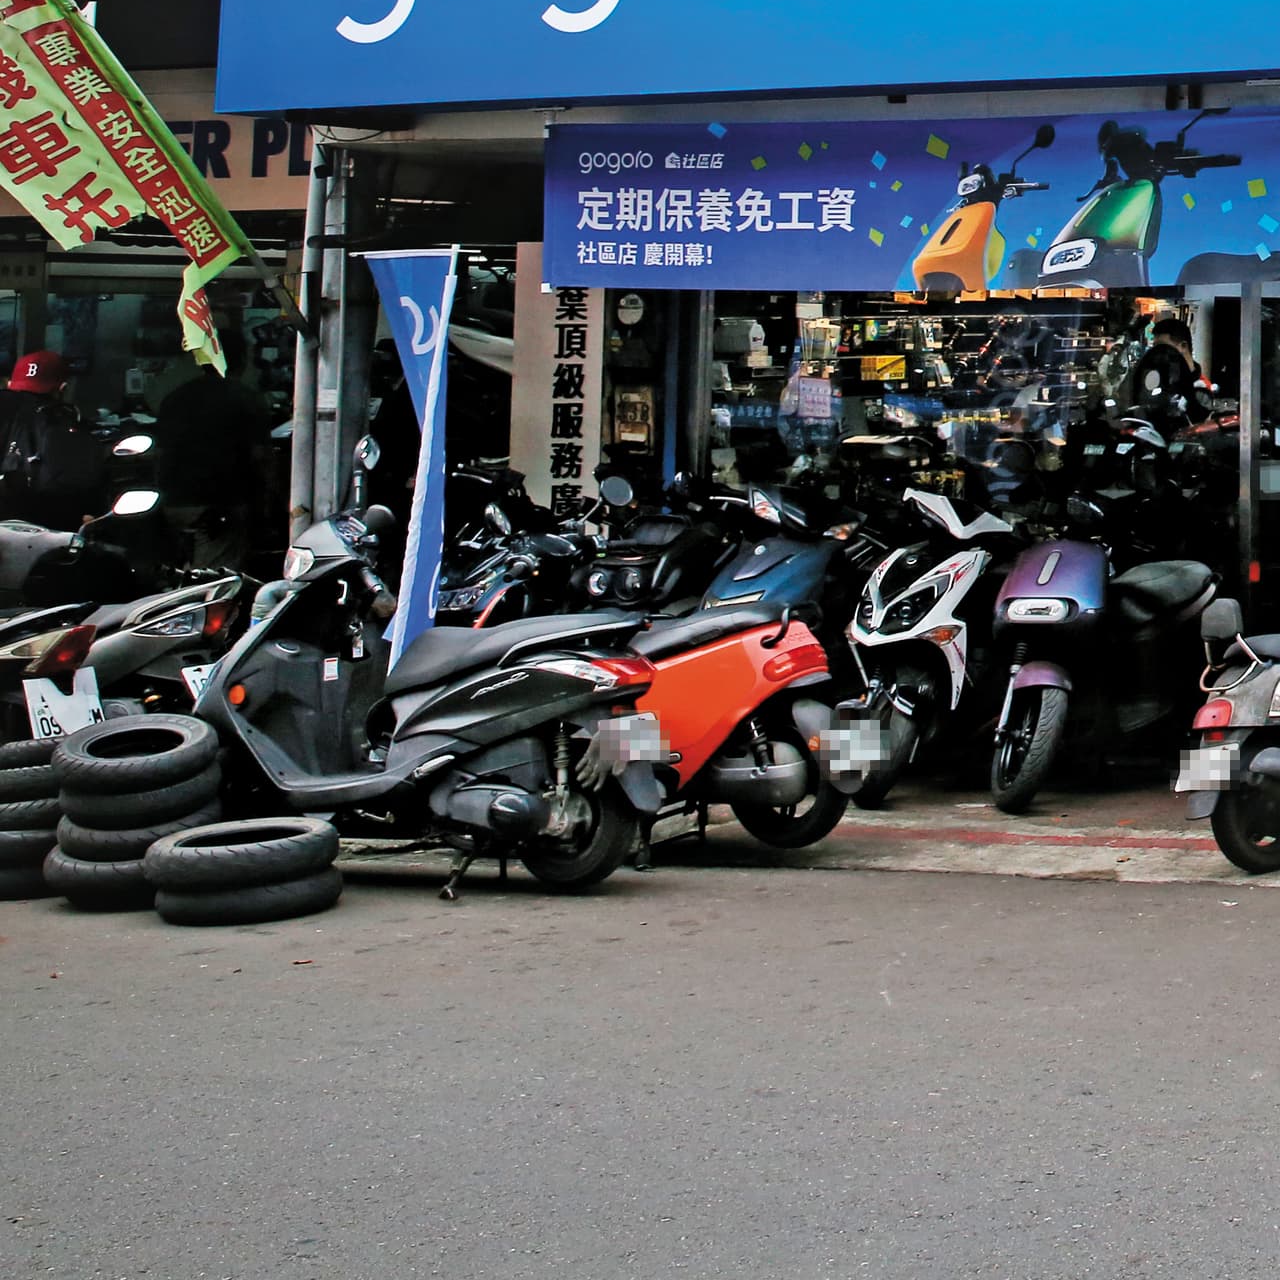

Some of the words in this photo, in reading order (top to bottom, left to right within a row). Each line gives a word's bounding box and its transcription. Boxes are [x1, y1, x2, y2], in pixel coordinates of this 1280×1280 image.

[579, 151, 653, 174] gogoro
[682, 153, 725, 169] 社區店
[577, 187, 856, 233] 定期保養免工資
[577, 241, 638, 266] 社區店
[643, 242, 713, 267] 慶開幕!
[26, 363, 38, 378] B
